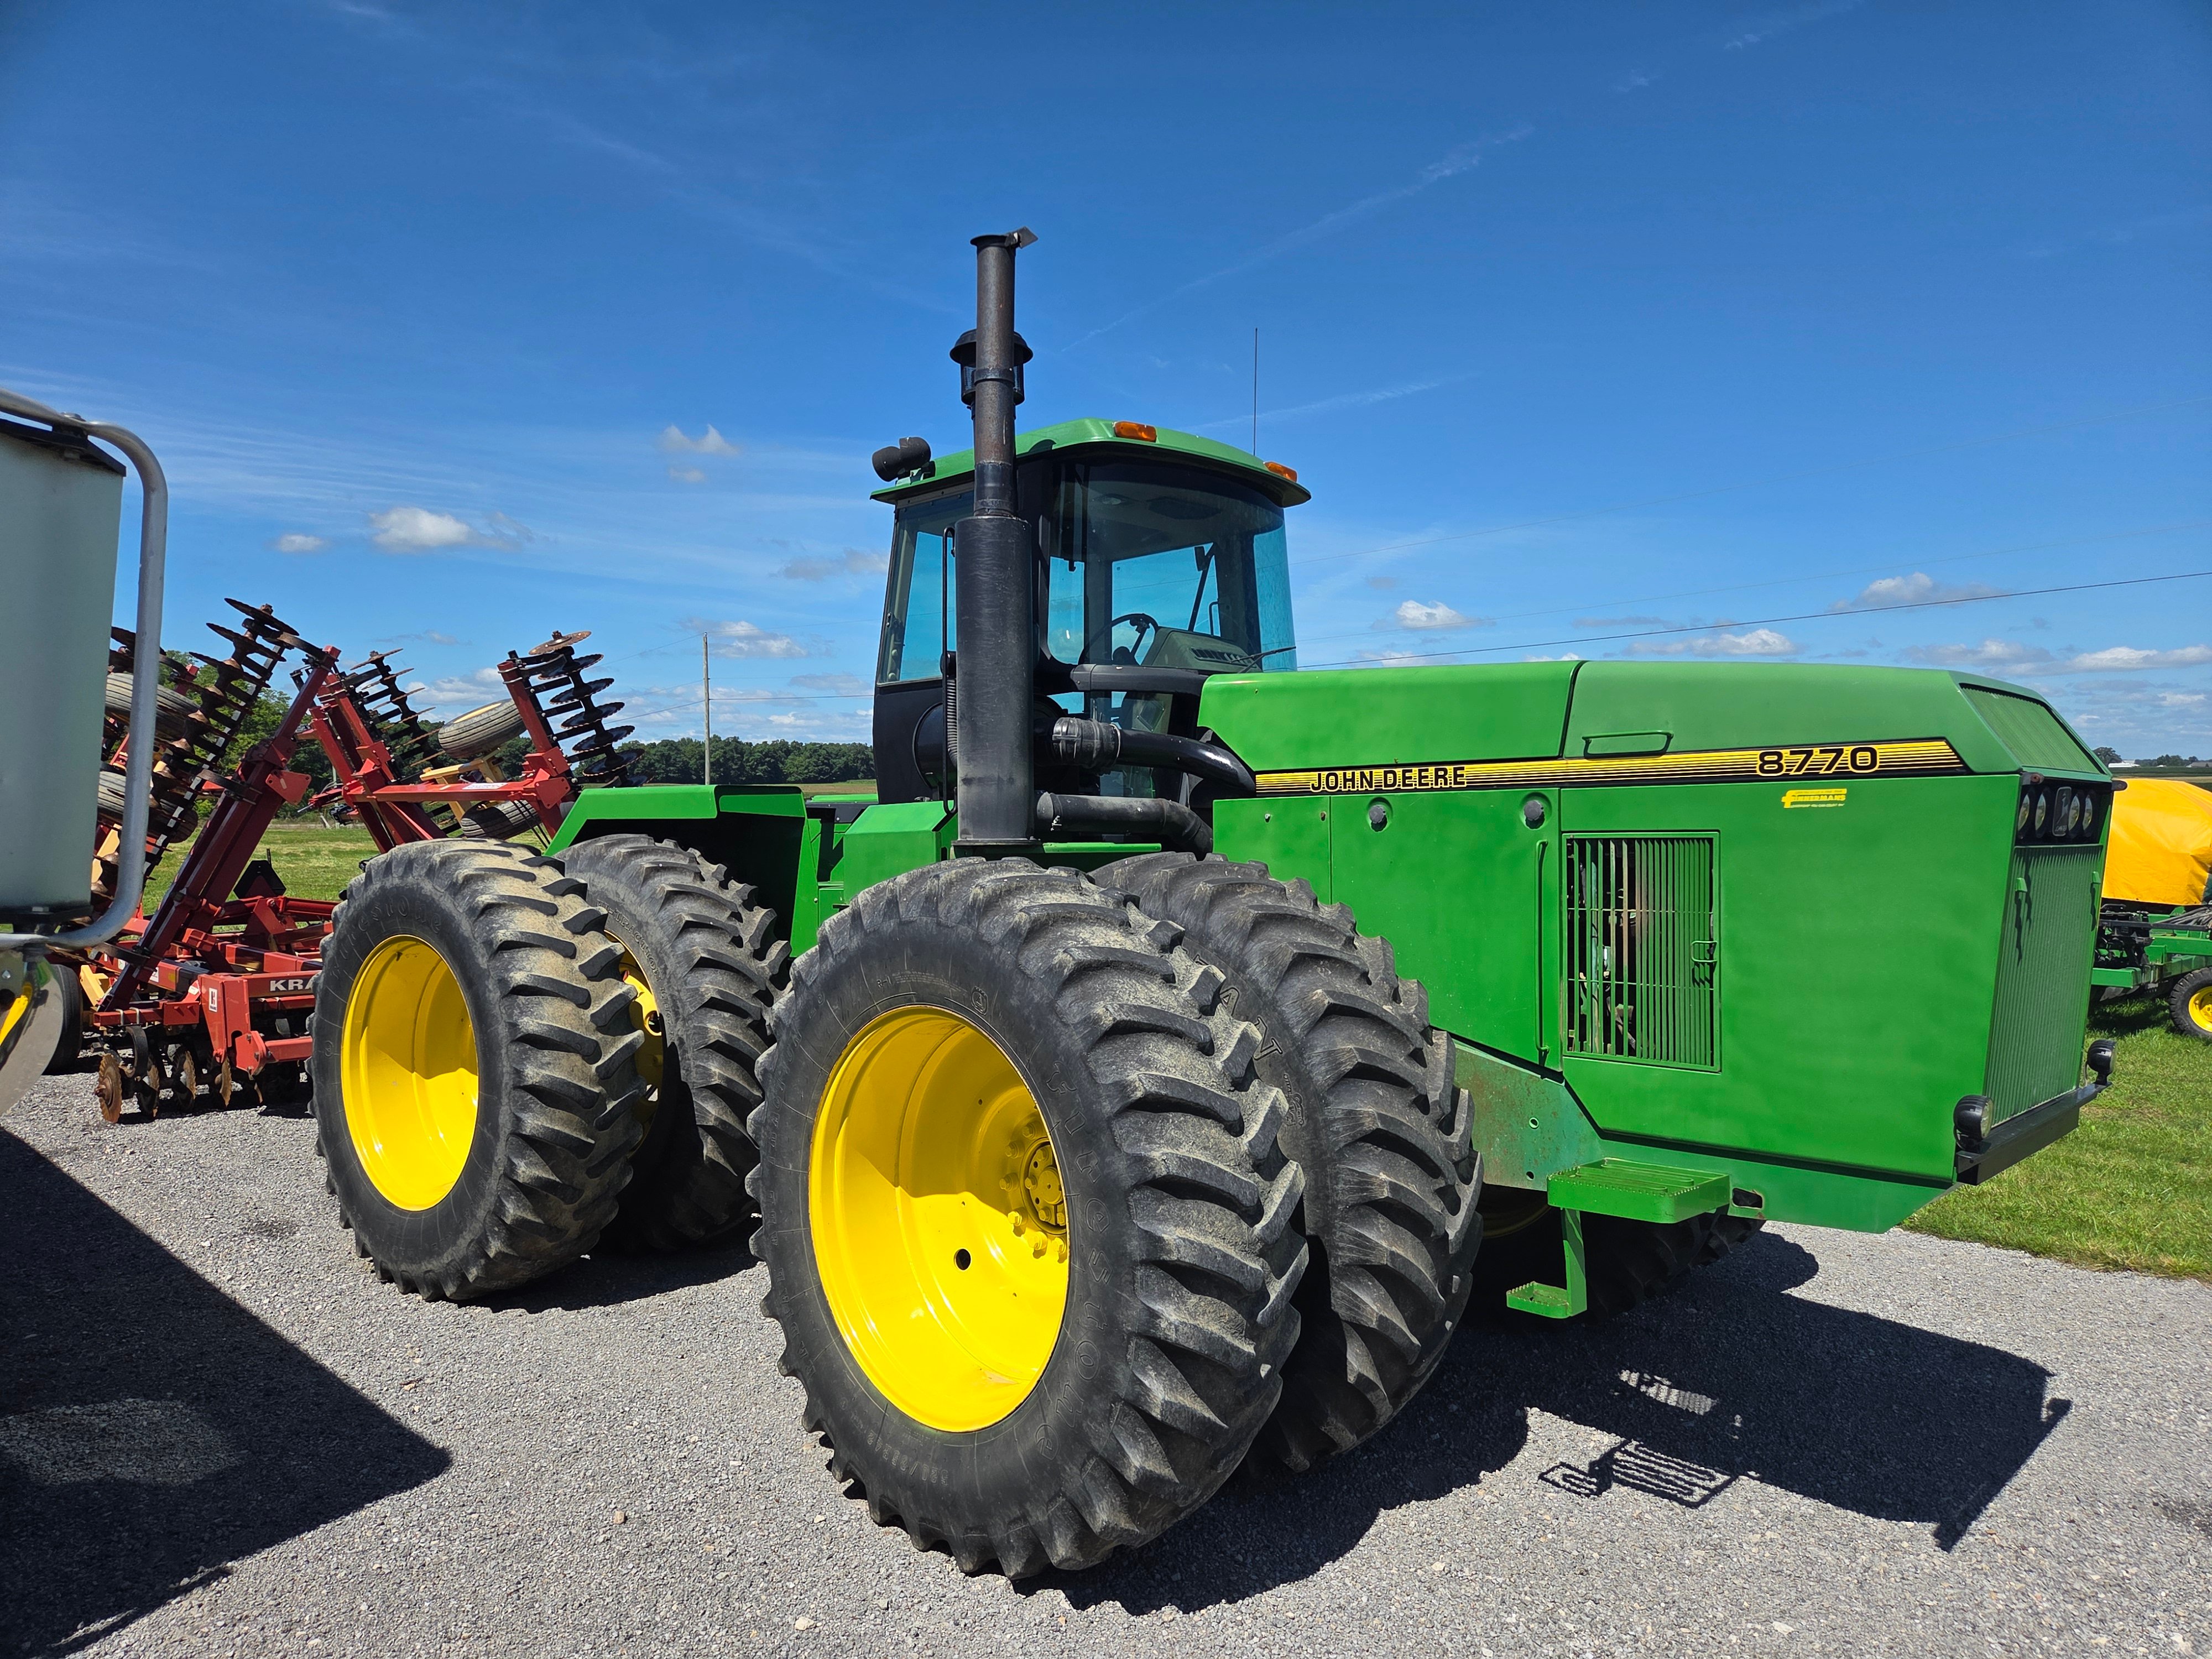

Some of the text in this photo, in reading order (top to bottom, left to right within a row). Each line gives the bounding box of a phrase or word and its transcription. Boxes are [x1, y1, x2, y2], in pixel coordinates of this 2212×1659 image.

[1756, 745, 1880, 776] 8770
[1311, 766, 1467, 792] JOHN DEERE
[1035, 1061, 1113, 1462] Firestone
